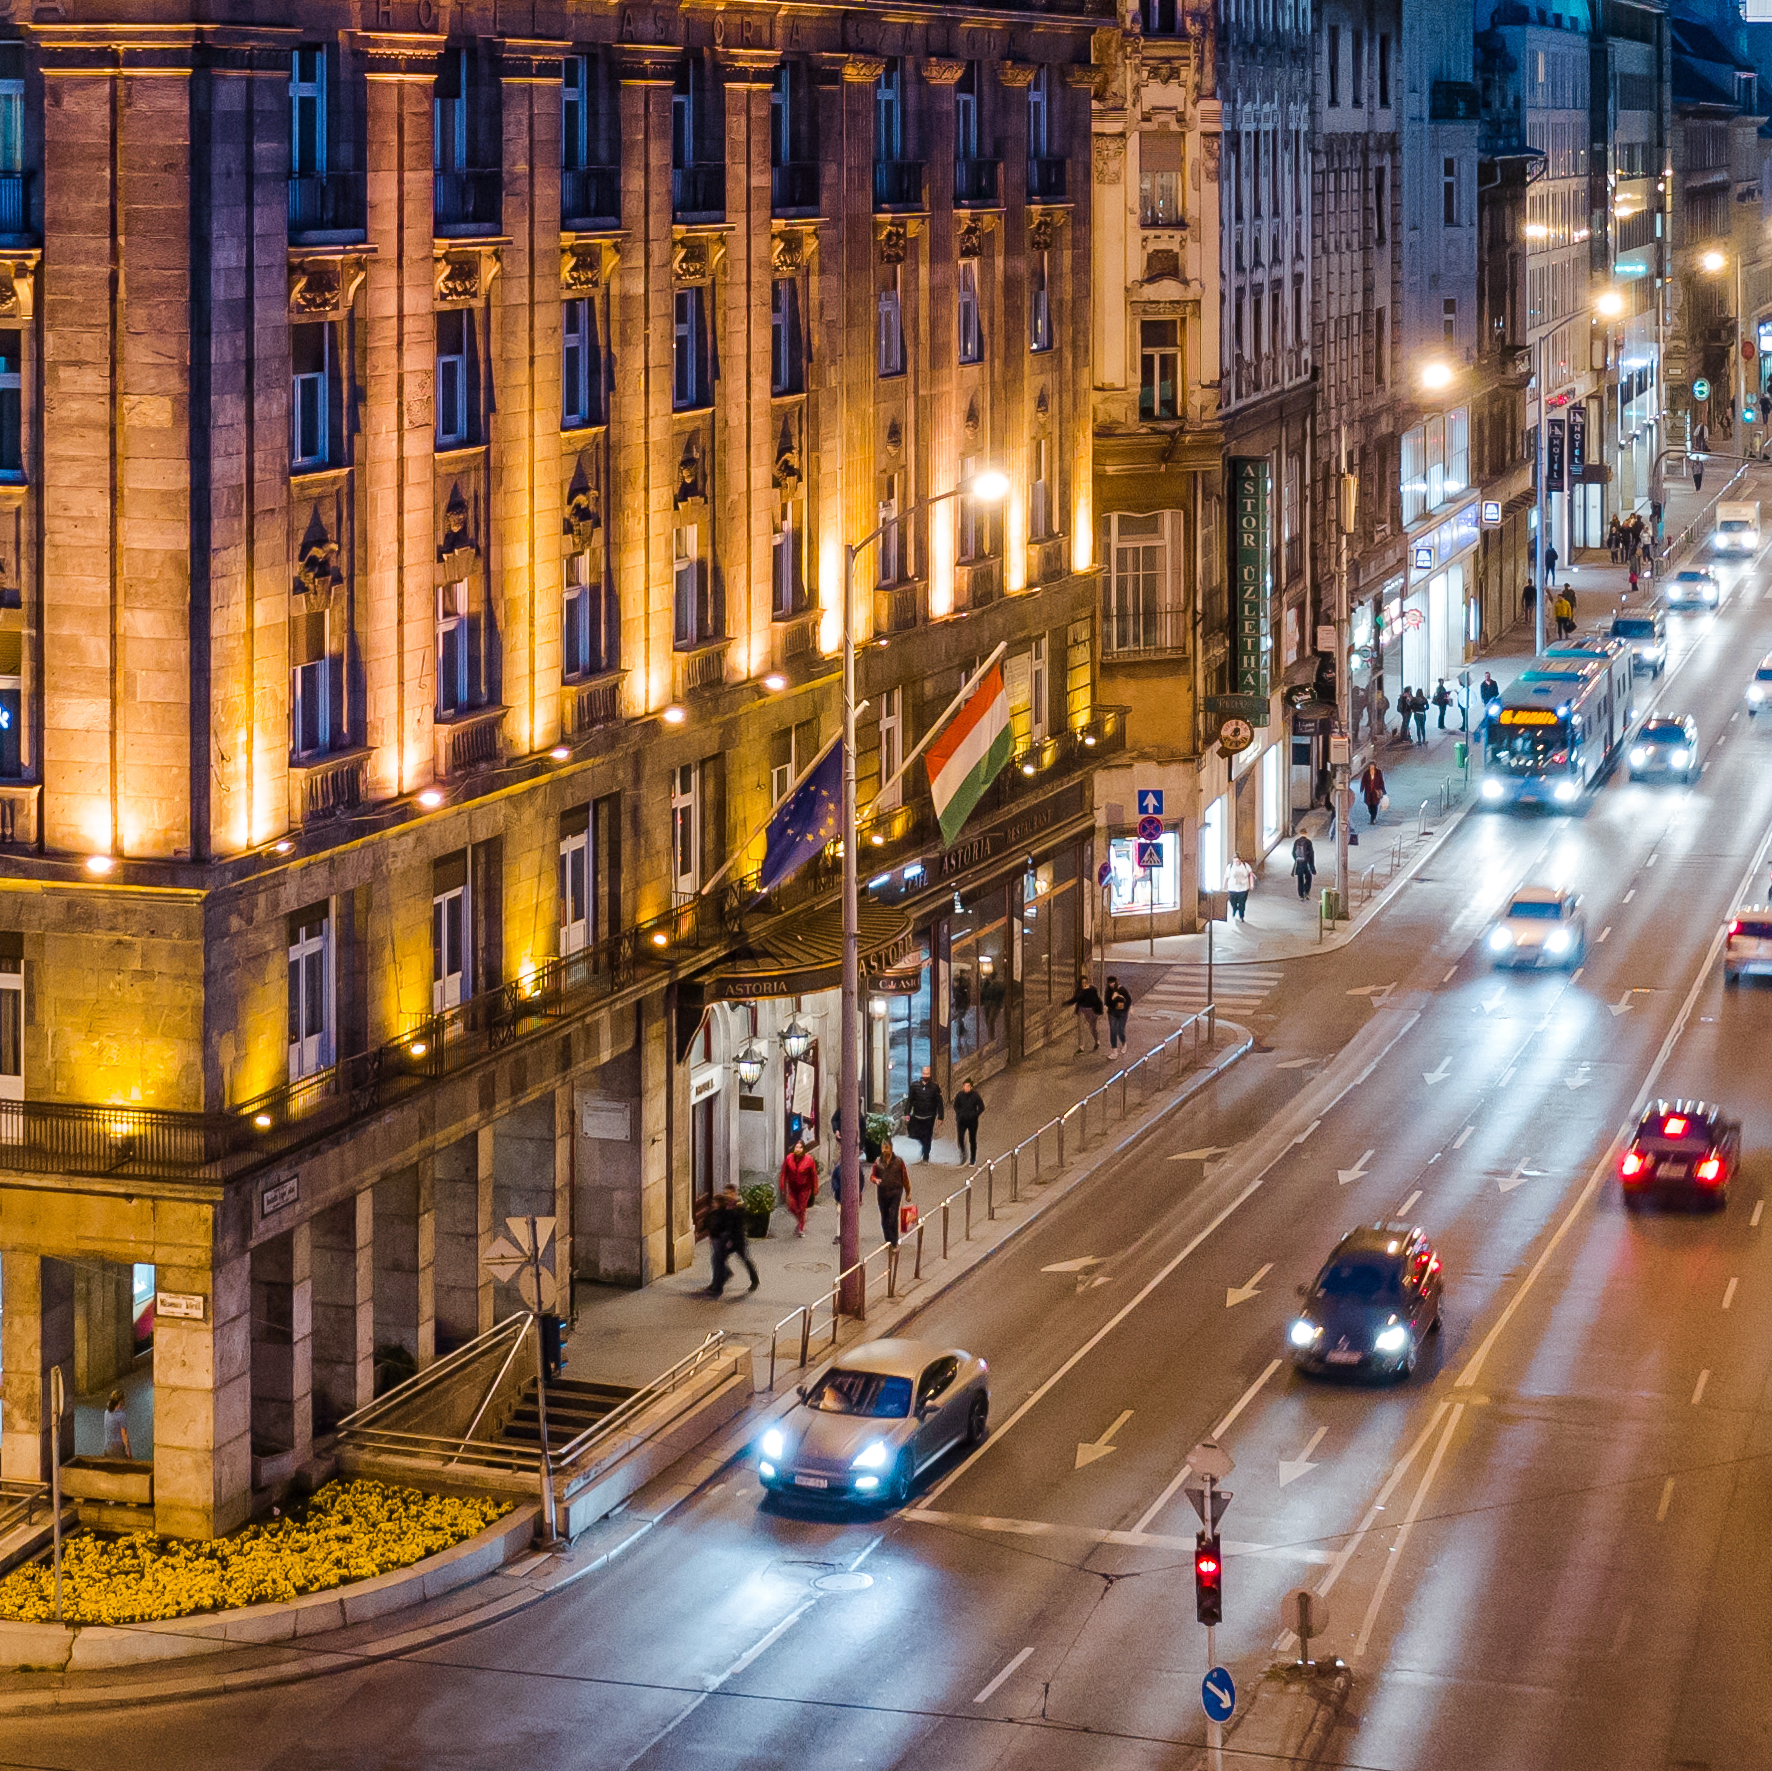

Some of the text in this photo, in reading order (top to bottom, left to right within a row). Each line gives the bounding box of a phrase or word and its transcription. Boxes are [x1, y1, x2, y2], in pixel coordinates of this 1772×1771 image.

[1242, 463, 1257, 548] ASTOR
[941, 836, 991, 876] ASTORIA
[725, 980, 788, 997] ASTORIA
